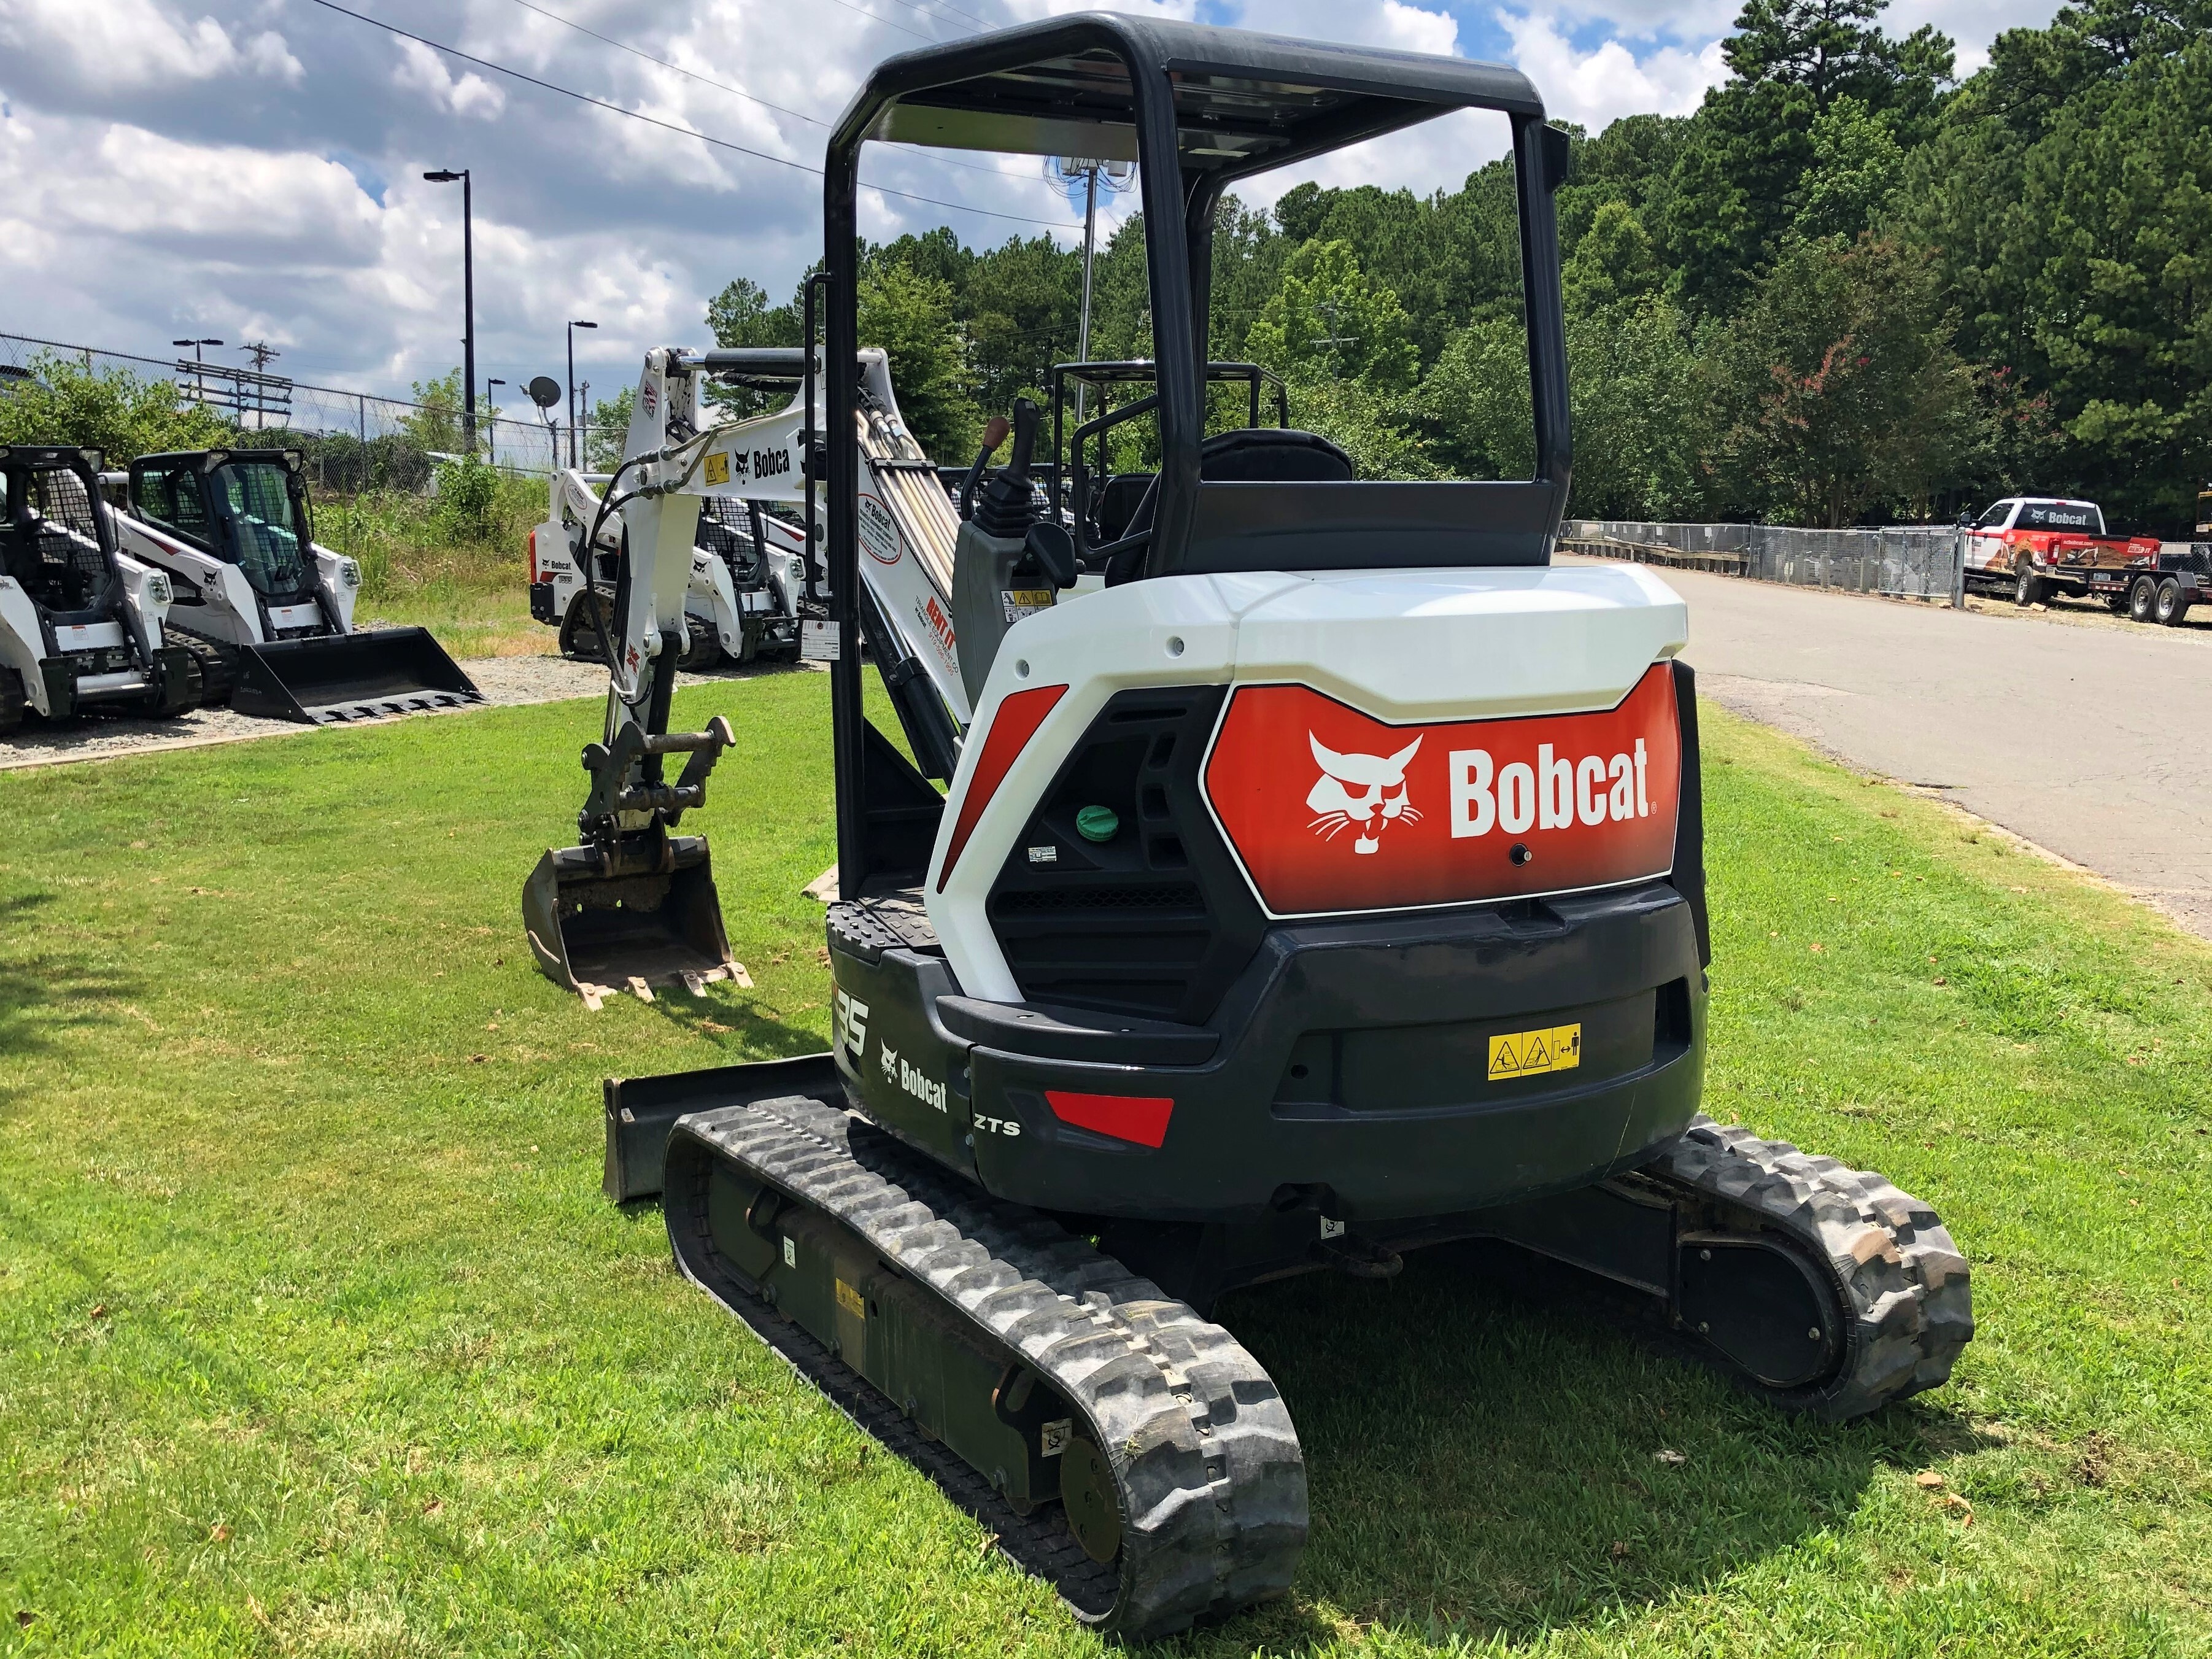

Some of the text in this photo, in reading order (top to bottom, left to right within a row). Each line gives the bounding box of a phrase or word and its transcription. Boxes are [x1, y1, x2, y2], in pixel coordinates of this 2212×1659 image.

[754, 447, 790, 479] Bobca
[872, 504, 891, 531] Bobcat
[2049, 511, 2087, 525] Bobcat
[551, 560, 571, 570] Bobcat
[915, 595, 933, 628] TRIANGLE
[932, 626, 953, 663] EQUIPMENT
[926, 595, 956, 651] RENT IT
[1449, 738, 1649, 838] Bobcat
[901, 1059, 948, 1114] Bobcat
[974, 1113, 1021, 1136] ZTS
